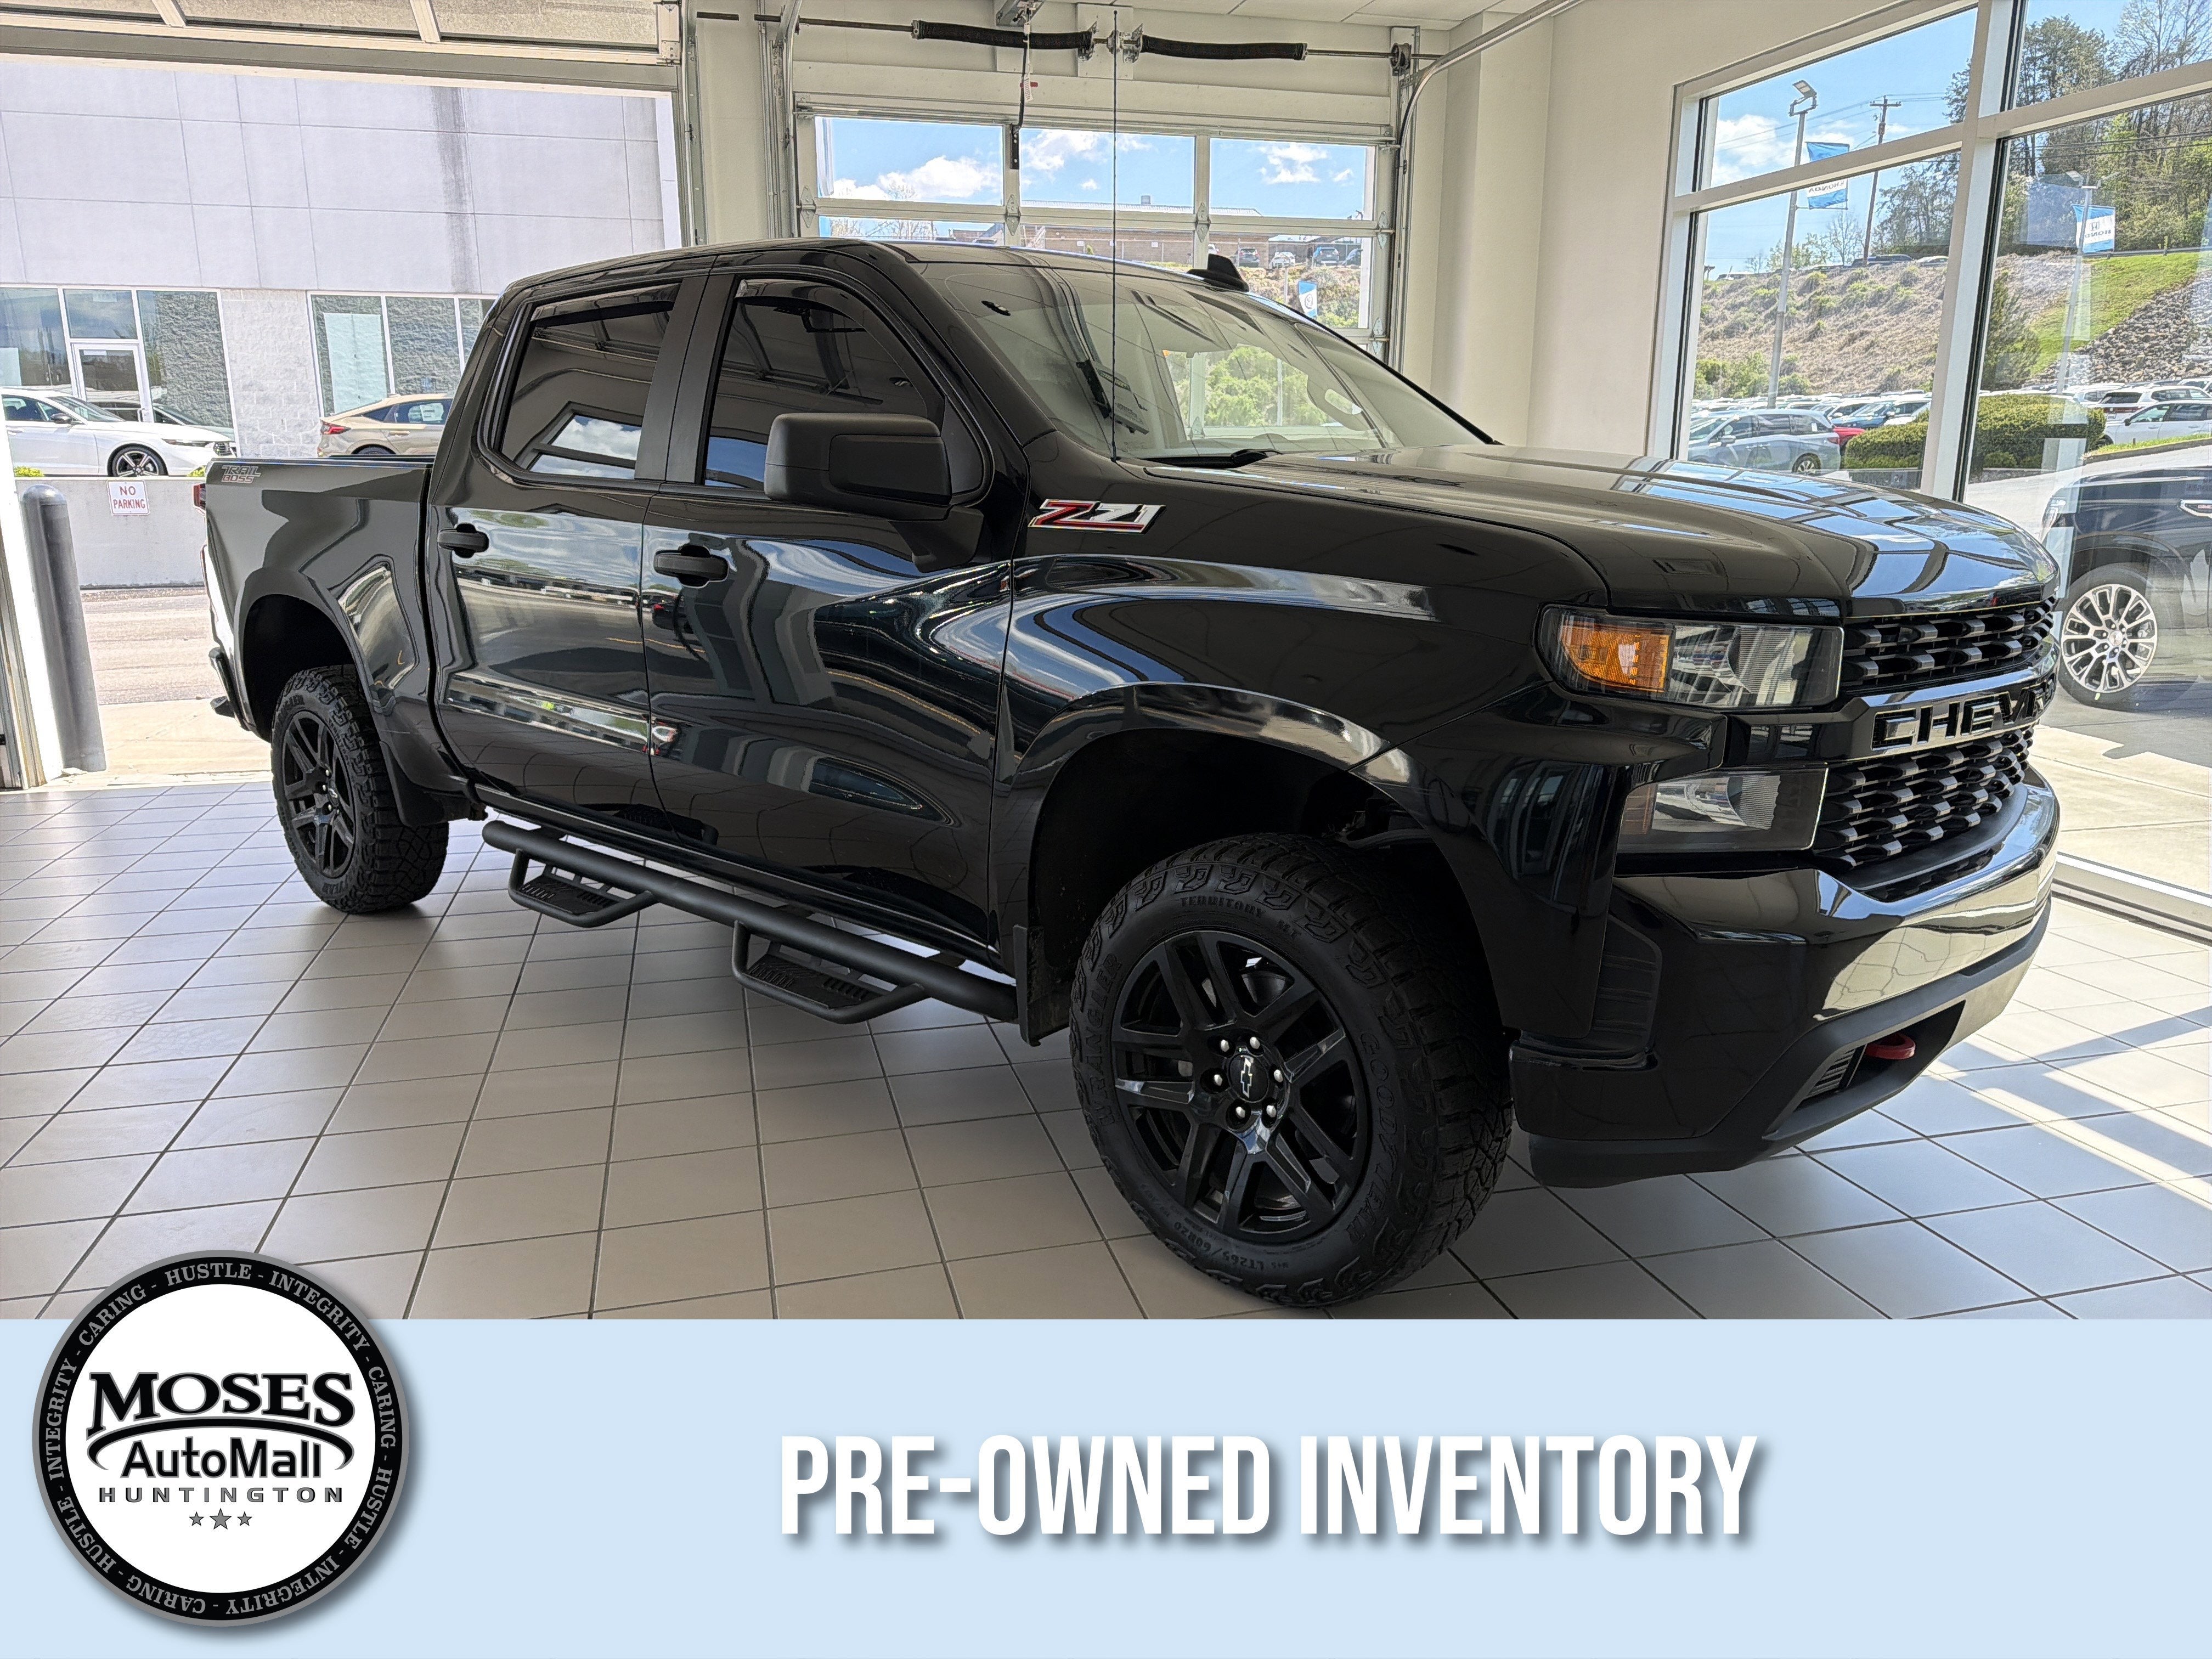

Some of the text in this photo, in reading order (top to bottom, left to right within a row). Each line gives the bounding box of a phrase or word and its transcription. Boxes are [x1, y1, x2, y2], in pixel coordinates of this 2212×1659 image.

[221, 474, 254, 483] BOSS
[222, 465, 261, 477] TRAIL
[120, 486, 136, 495] NO
[113, 499, 145, 509] PARKING
[1028, 499, 1166, 534] Z71
[1180, 896, 1266, 918] TERRITORY
[1086, 952, 1122, 1125] WRANGLER
[1346, 1033, 1398, 1244] GOODYEAR
